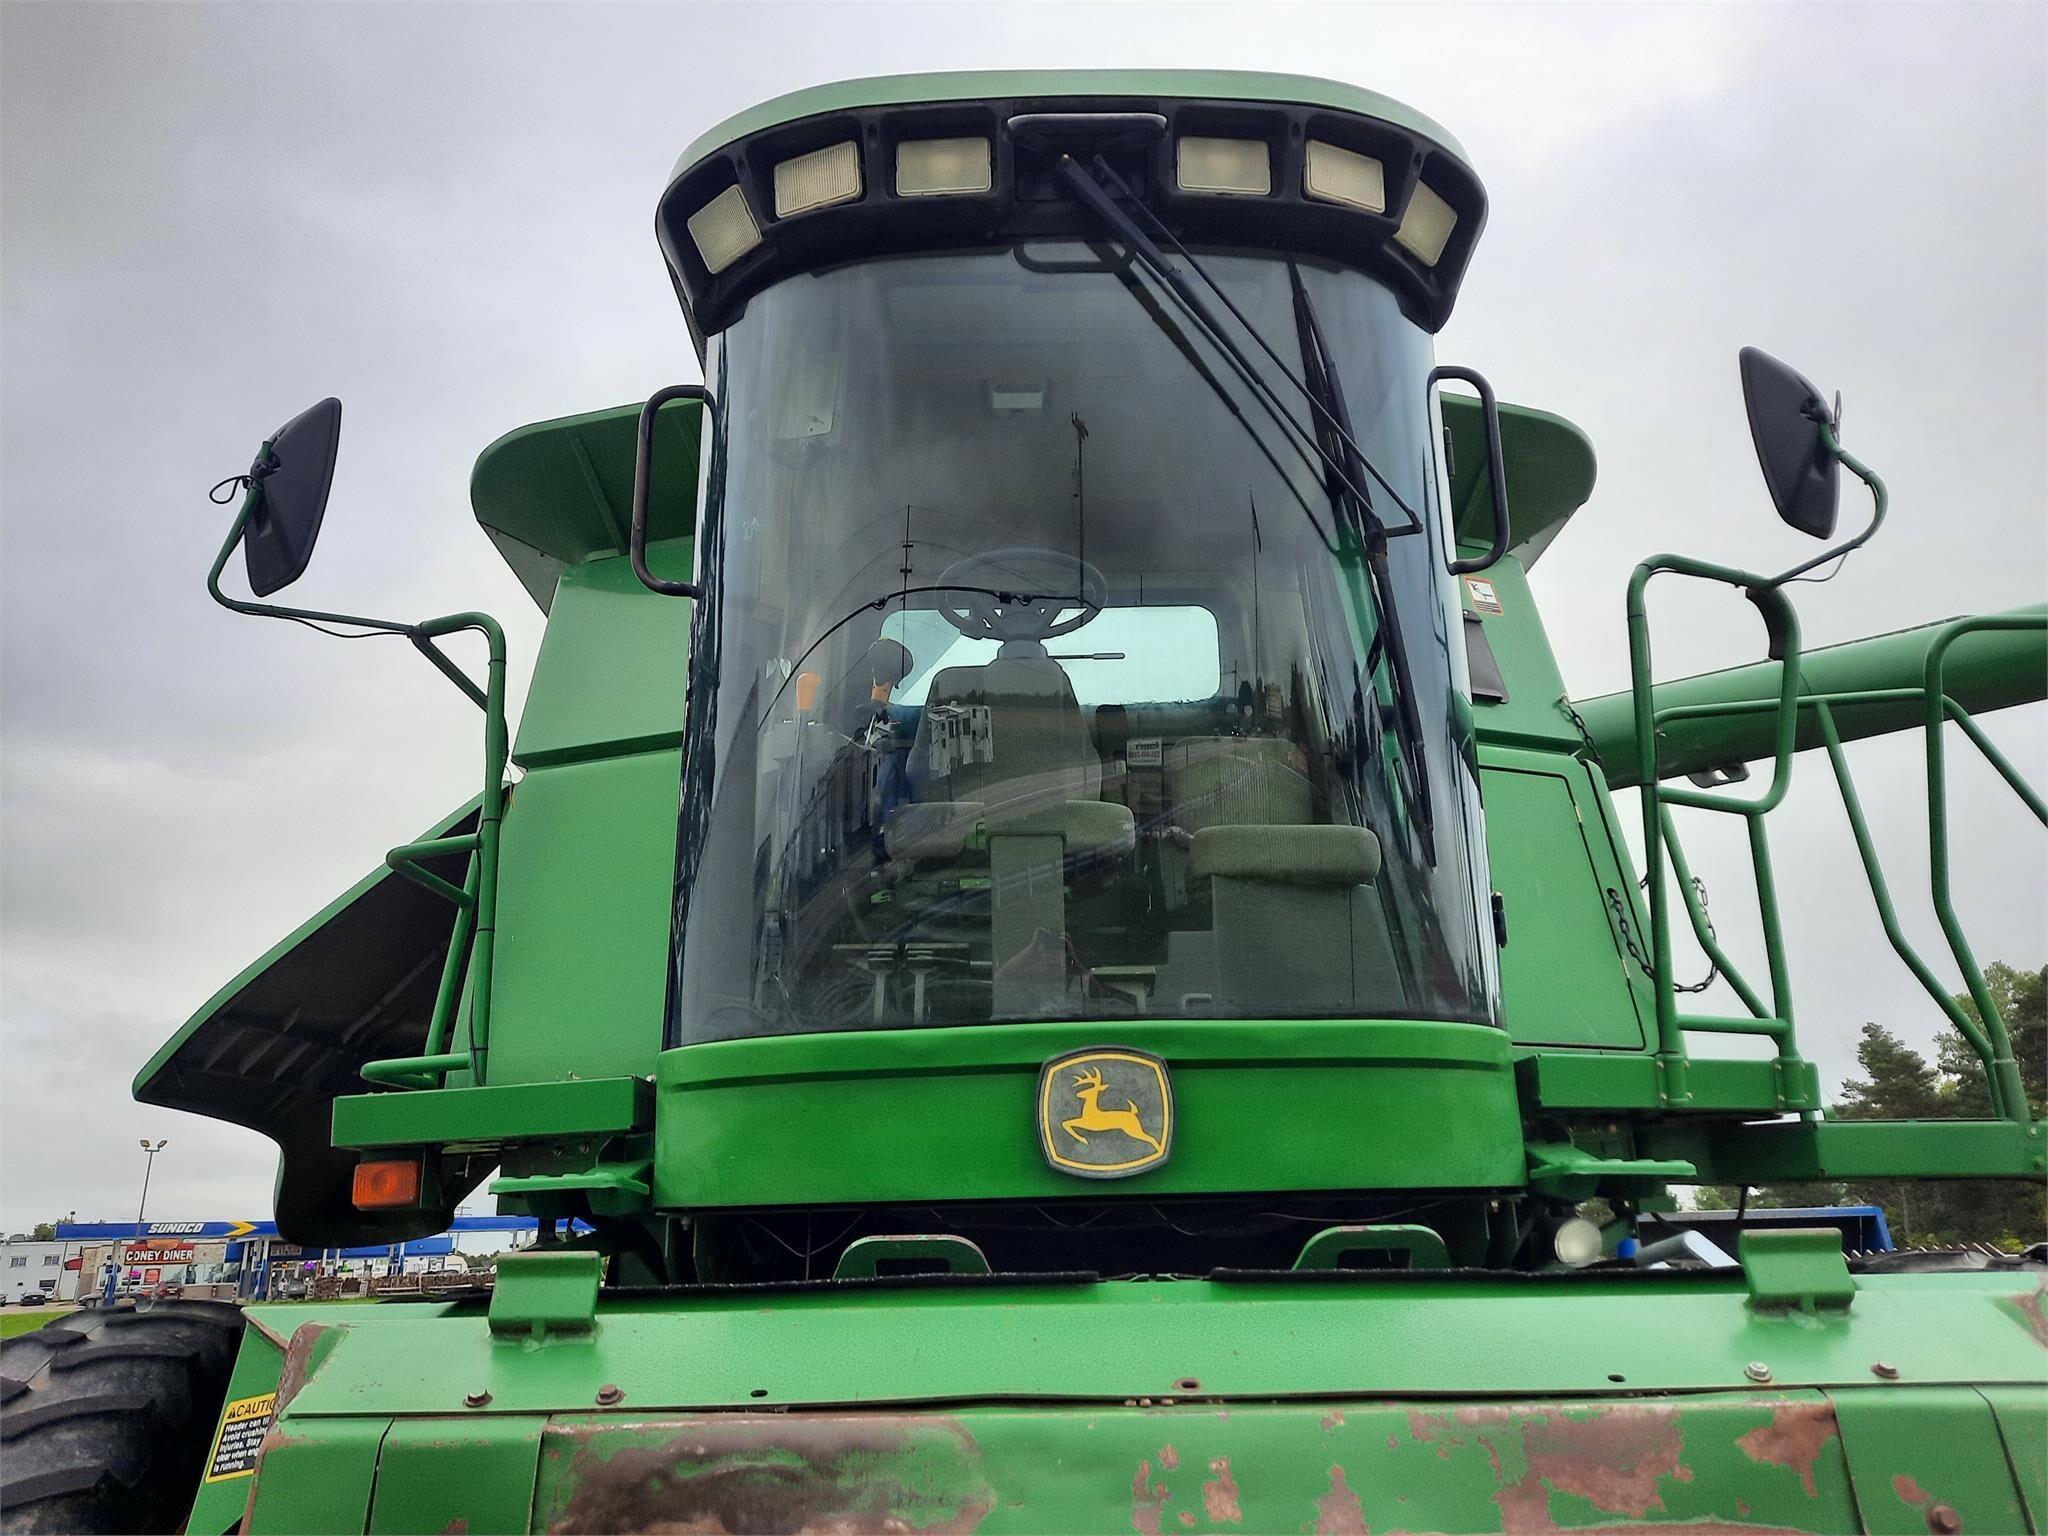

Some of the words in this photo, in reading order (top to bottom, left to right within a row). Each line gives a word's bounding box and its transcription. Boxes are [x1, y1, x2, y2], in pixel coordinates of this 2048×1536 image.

[148, 1223, 205, 1234] SUNOCO
[126, 1250, 163, 1261] CONEY
[164, 1250, 193, 1261] DINER
[246, 1438, 261, 1448] Stay
[231, 1450, 247, 1459] when
